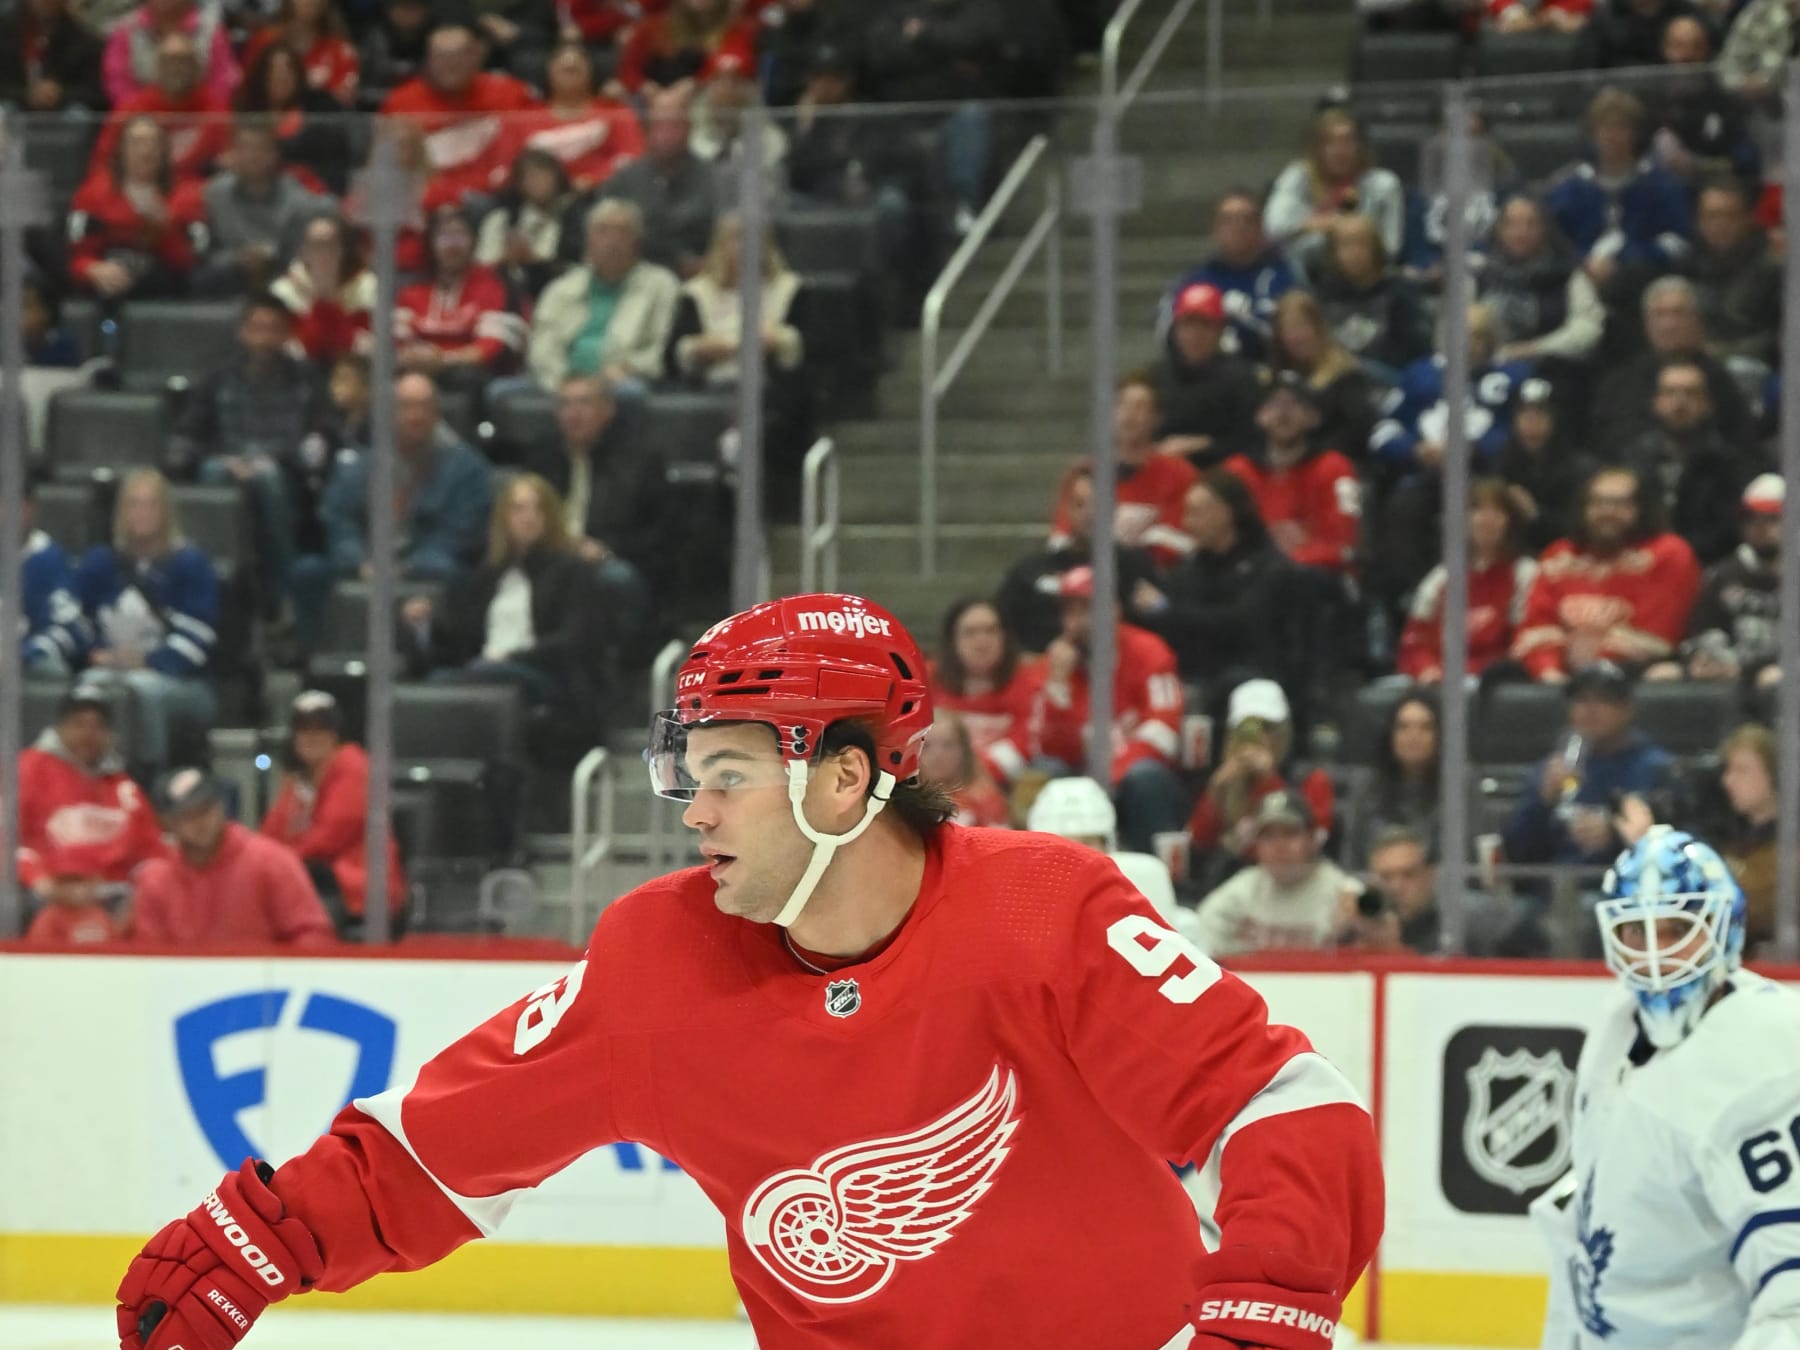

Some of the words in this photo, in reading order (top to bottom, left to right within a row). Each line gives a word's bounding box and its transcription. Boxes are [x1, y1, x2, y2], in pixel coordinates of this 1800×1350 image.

[797, 605, 893, 639] meijer
[679, 671, 706, 689] CCM
[1738, 1113, 1800, 1194] 6
[207, 1289, 248, 1330] REKKER
[1199, 1300, 1336, 1340] SHERWO
